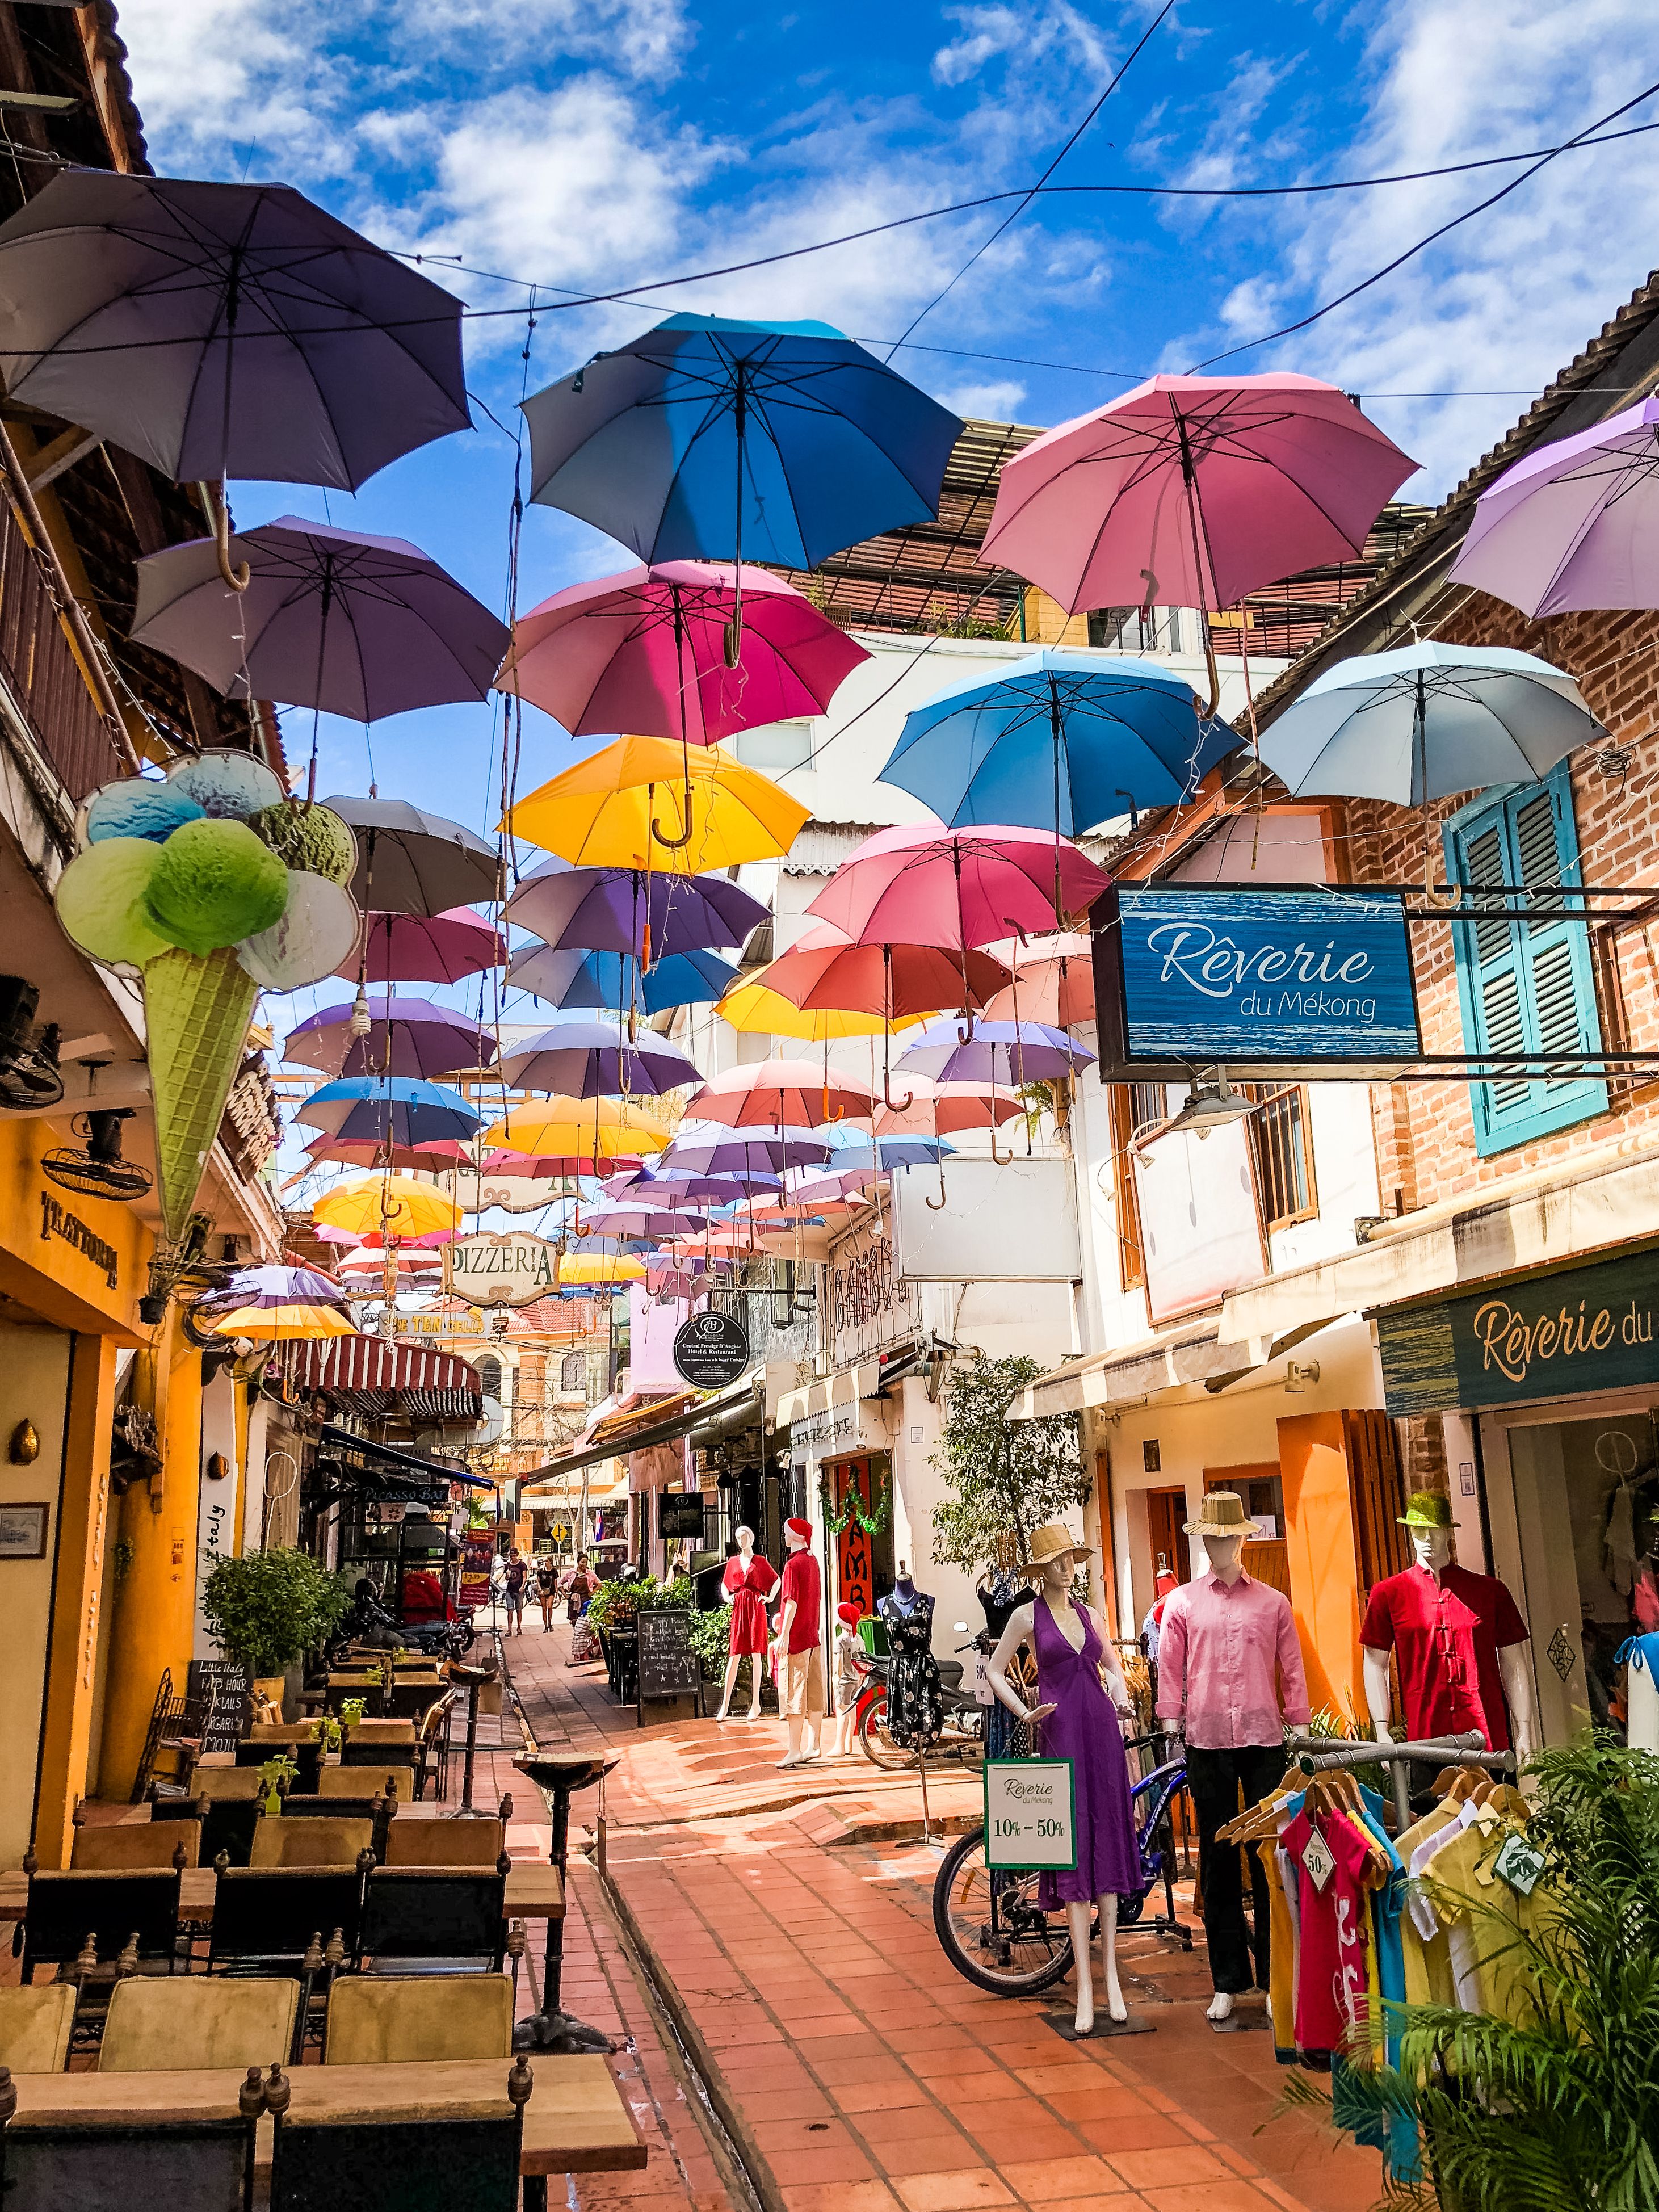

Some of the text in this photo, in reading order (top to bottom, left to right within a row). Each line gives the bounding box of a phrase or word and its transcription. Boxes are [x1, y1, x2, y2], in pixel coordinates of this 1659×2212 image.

[1148, 922, 1375, 997] Rêverie
[1240, 990, 1376, 1023] du Mékong
[447, 1246, 554, 1287] PIZZERIA
[413, 1315, 442, 1332] TEN
[1474, 1299, 1654, 1382] Rêverie du
[362, 1487, 446, 1501] Picasso Bar
[223, 1663, 245, 1678] Italy
[226, 1678, 247, 1691] HOUR
[1037, 1819, 1065, 1837] 50%
[1308, 1853, 1328, 1874] 50%
